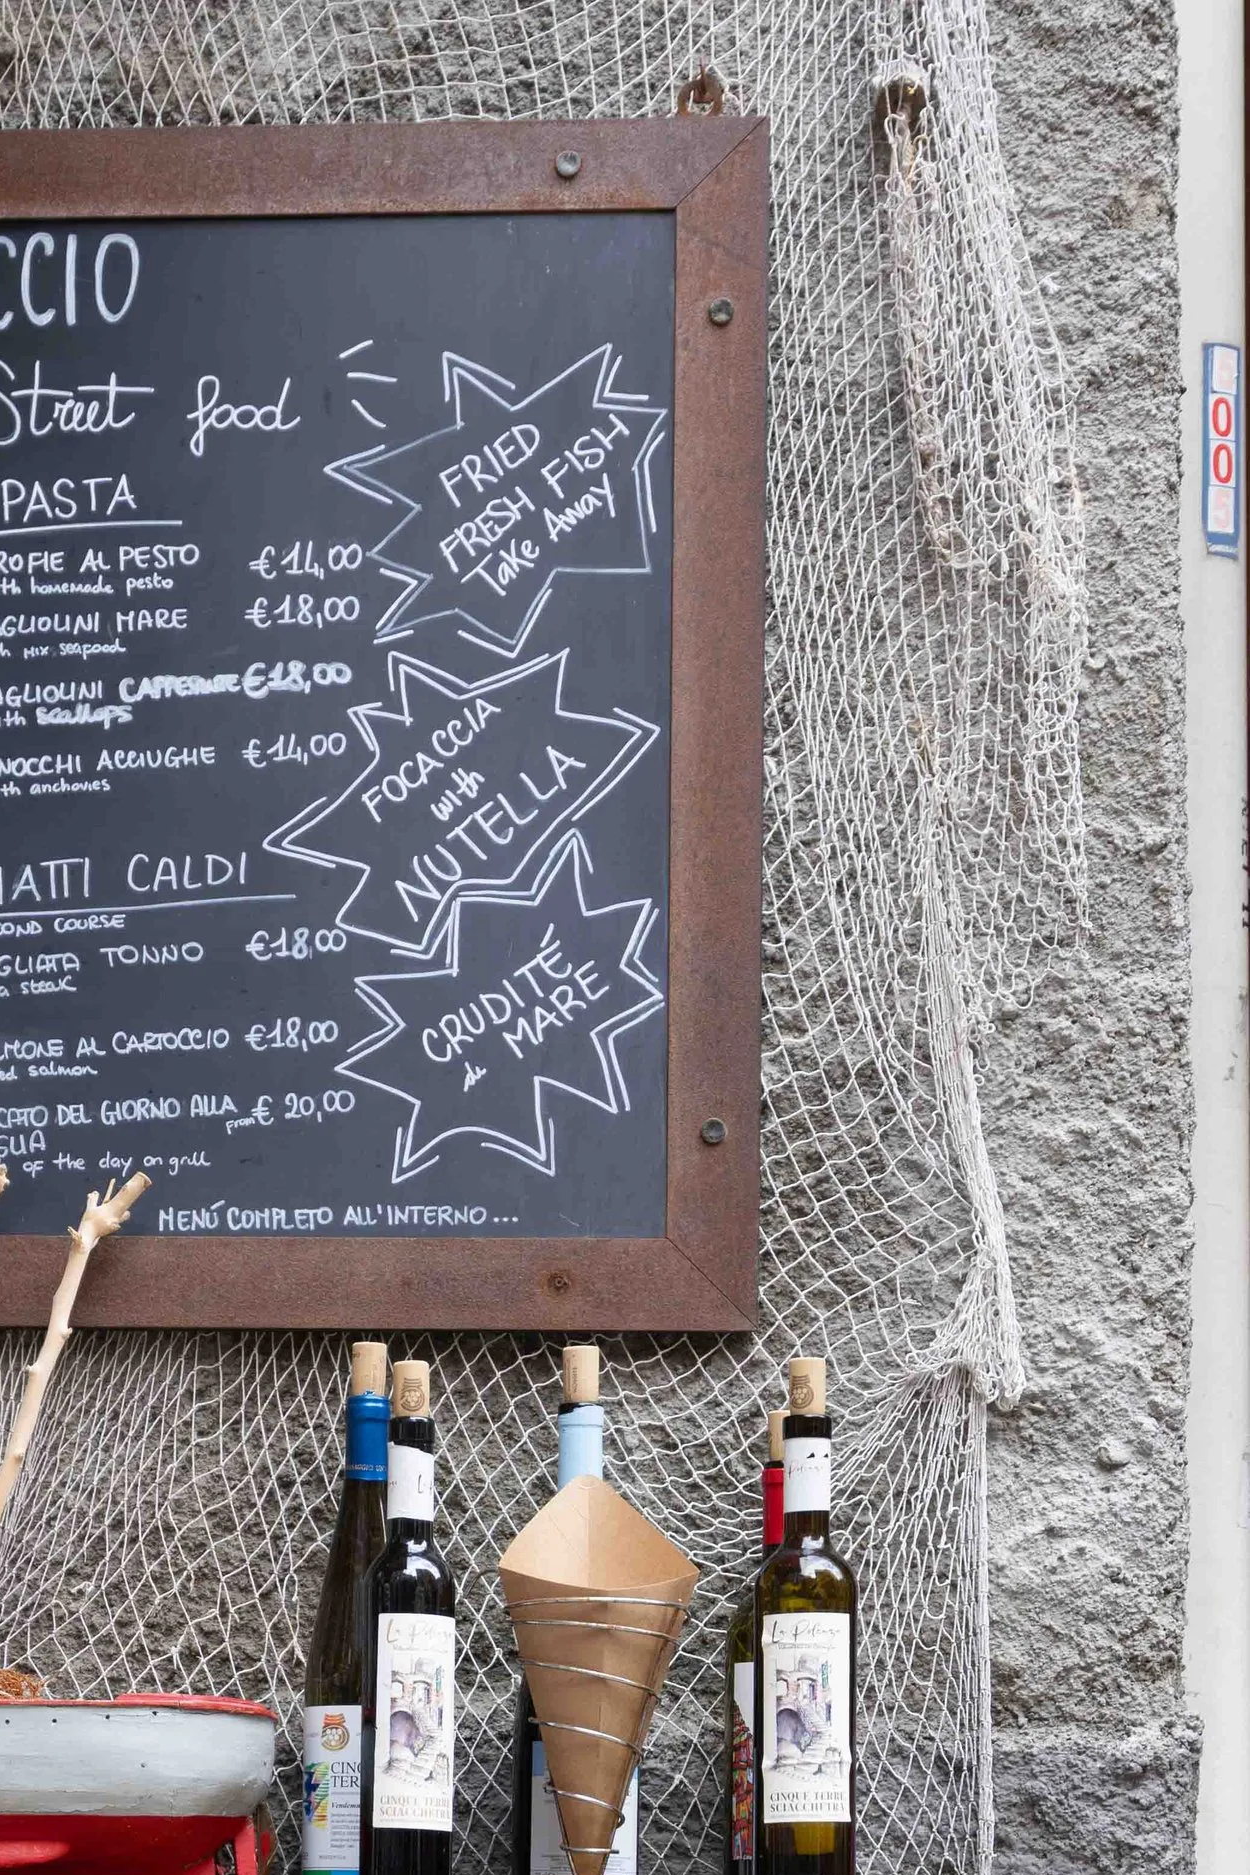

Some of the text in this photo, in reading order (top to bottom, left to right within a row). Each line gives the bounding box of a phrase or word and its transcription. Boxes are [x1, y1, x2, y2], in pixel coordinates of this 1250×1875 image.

[186, 374, 301, 457] food
[438, 423, 541, 508] FRIED
[0, 473, 139, 523] PASTA
[439, 412, 631, 574] FRESH FISH
[542, 471, 616, 543] Away
[79, 548, 111, 573] AL
[119, 543, 200, 572] PESTO
[125, 571, 174, 597] pesto
[116, 593, 360, 633] MARE €18,00
[96, 746, 216, 771] ACCIUGHE
[241, 732, 347, 768] €14,00
[361, 698, 502, 823] FOCACCIA
[29, 777, 111, 795] anchovies
[430, 767, 486, 822] with
[393, 745, 594, 923] NUTELLA
[127, 851, 247, 892] CALDI
[53, 913, 127, 933] COURSE
[99, 941, 204, 968] TONNO
[245, 927, 347, 961] €18,00
[501, 959, 611, 1060] MARE
[75, 1036, 107, 1059] AL
[111, 1027, 230, 1055] CARTOCCIO
[244, 1016, 339, 1052] €18,00
[27, 1060, 99, 1077] salmon
[56, 1103, 93, 1126] DEL
[100, 1096, 181, 1126] GIORNO
[190, 1094, 239, 1119] ALLA
[52, 1150, 163, 1178] the day on
[226, 1206, 334, 1231] COMPLETO
